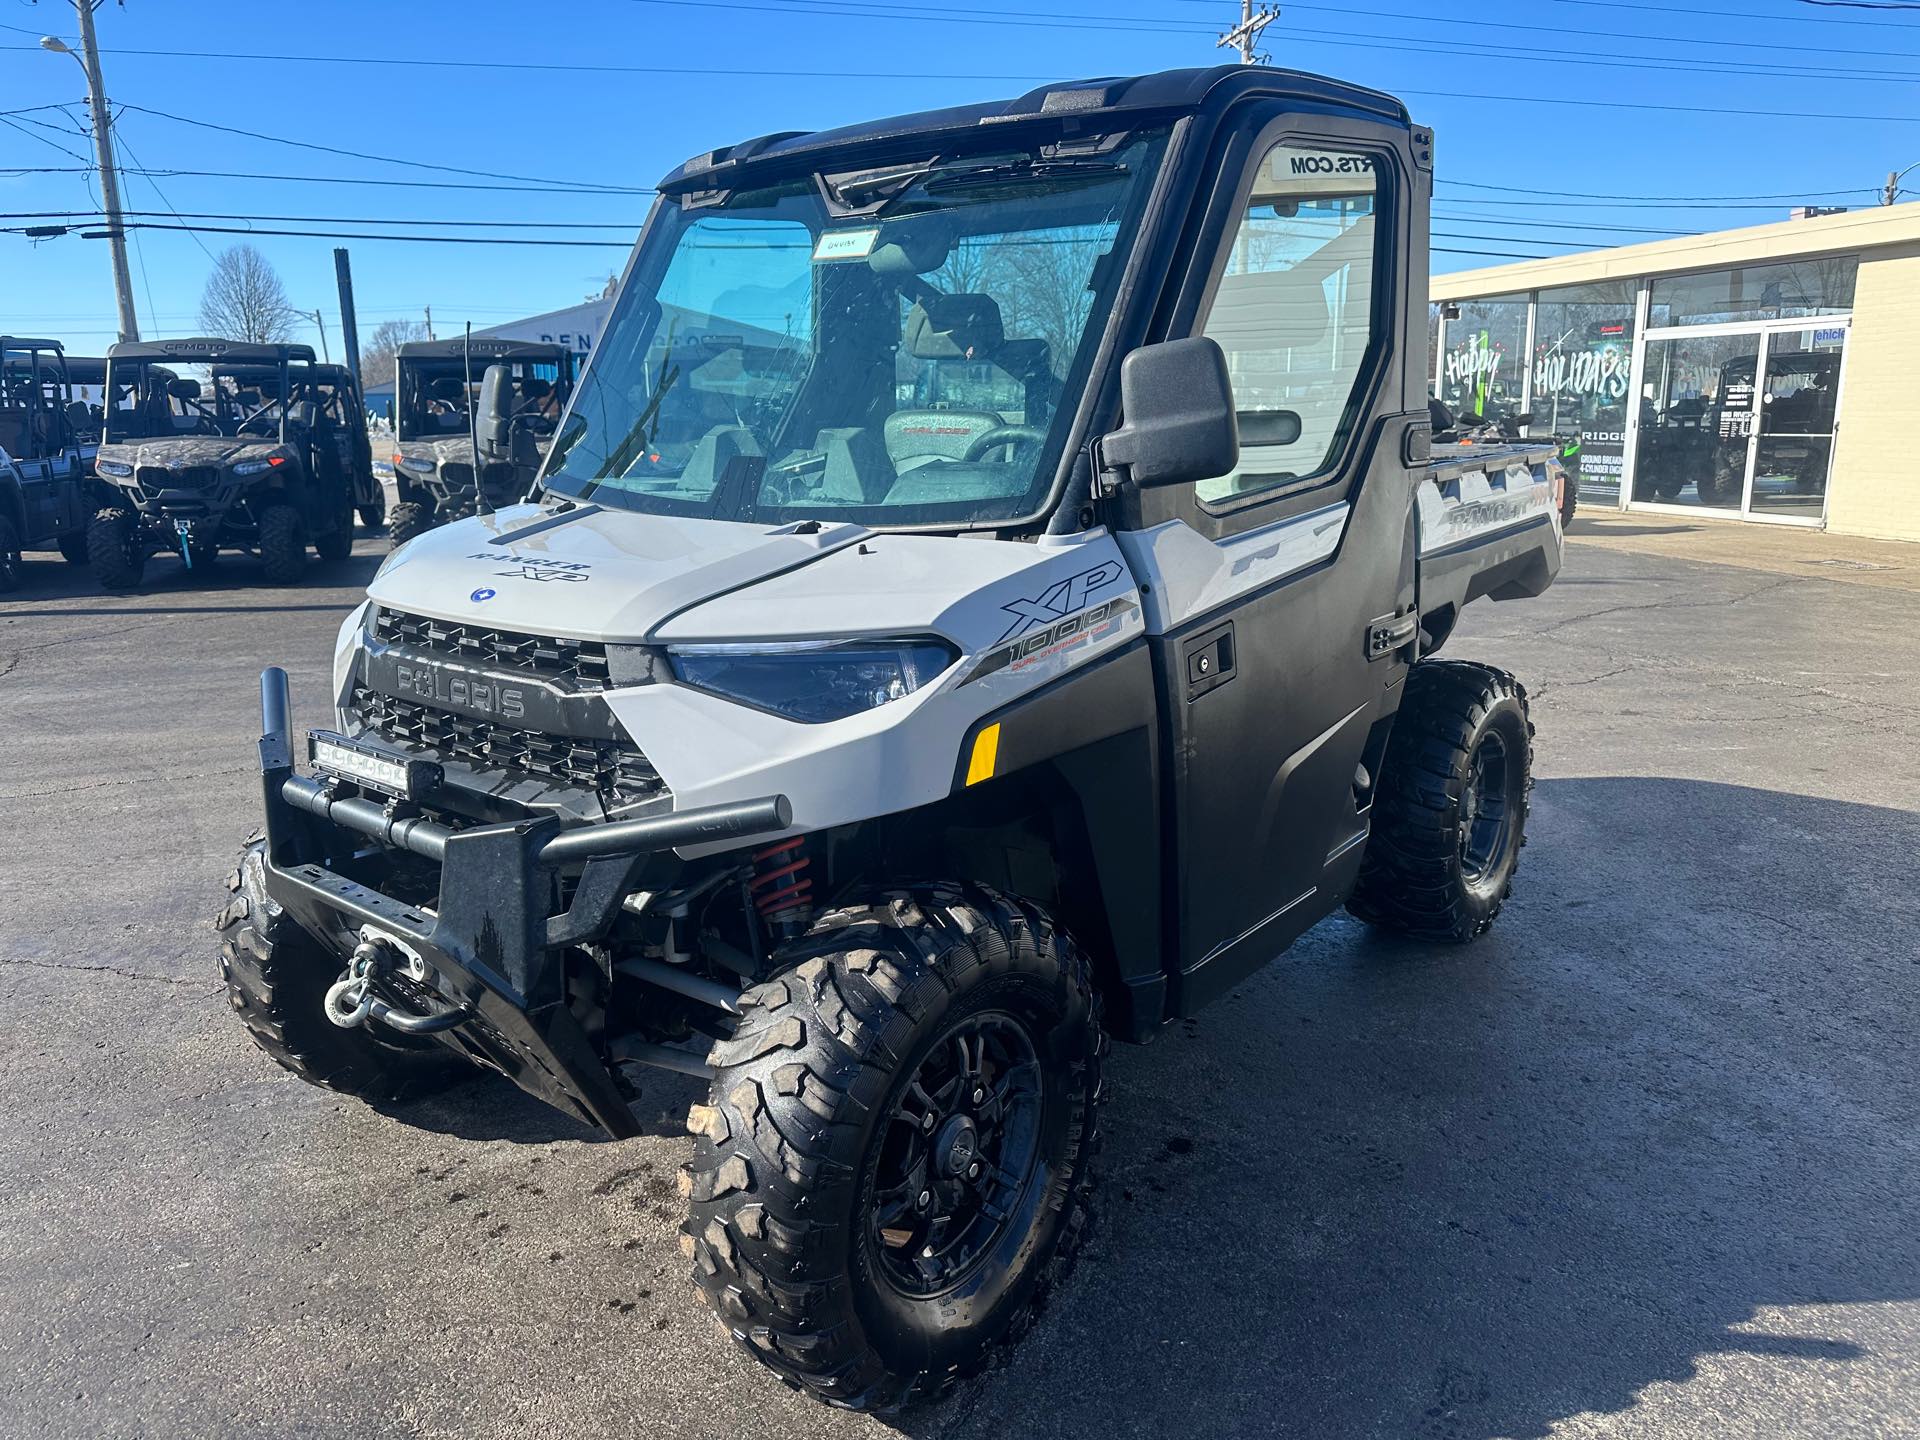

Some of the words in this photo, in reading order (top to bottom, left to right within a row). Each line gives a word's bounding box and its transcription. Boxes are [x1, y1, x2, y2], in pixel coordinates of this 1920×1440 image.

[164, 343, 228, 351] CFMOTO
[1445, 349, 1501, 402] Happy
[466, 553, 592, 571] RANGER
[493, 566, 590, 582] XP
[989, 559, 1124, 652] XP
[1009, 602, 1111, 663] 1000
[396, 664, 525, 719] POLARIS
